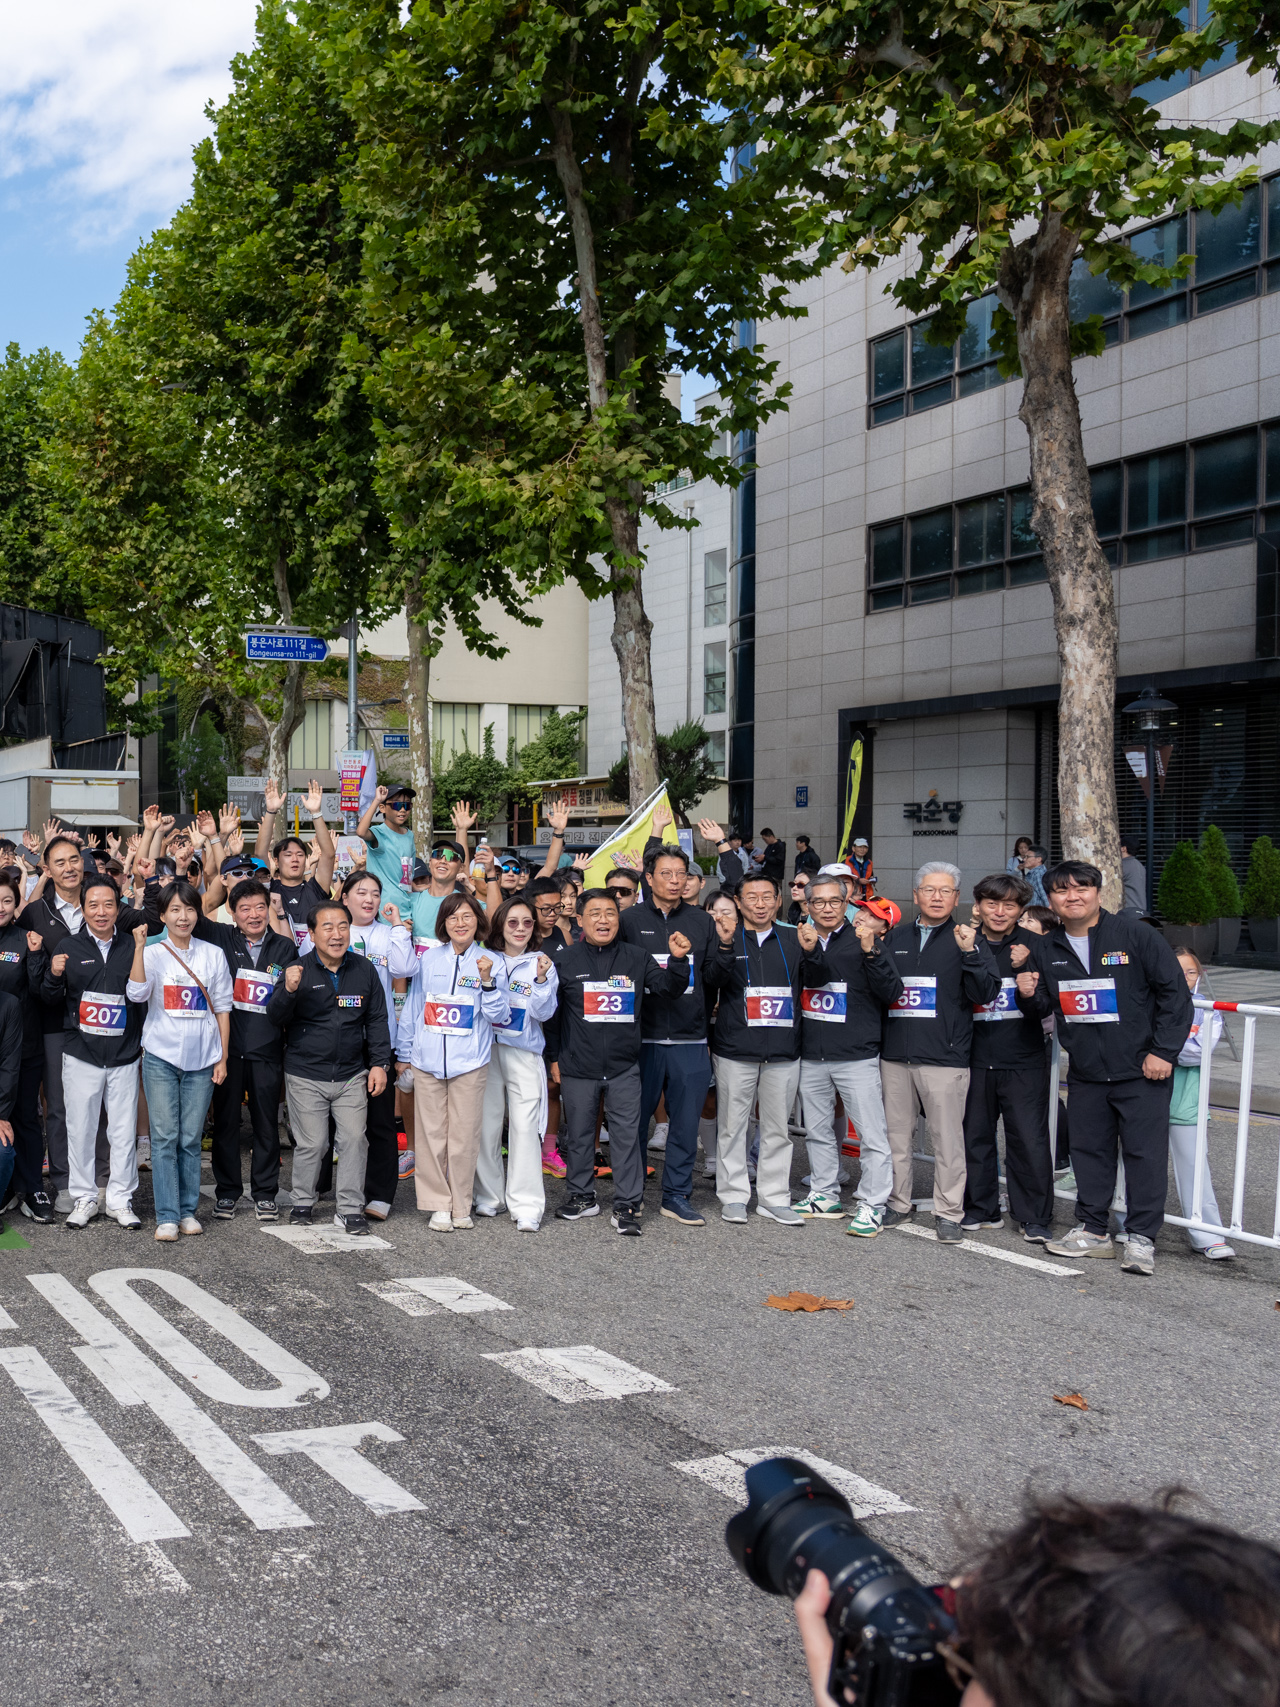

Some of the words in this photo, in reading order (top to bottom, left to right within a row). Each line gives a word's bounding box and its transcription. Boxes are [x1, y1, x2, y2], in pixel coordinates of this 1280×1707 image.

[249, 636, 307, 651] 봉은사로111길
[249, 649, 294, 659] Bongeunsa-ro
[295, 651, 317, 660] 111-gil
[561, 787, 577, 807] 정품
[578, 788, 592, 805] 정말
[903, 797, 964, 825] 국순당
[540, 830, 585, 845] 오교환
[913, 829, 959, 837] KOOKSOONDANG
[181, 990, 192, 1006] 9
[247, 984, 269, 1001] 19
[897, 990, 922, 1007] 55
[597, 995, 622, 1012] 23
[760, 999, 784, 1016] 37
[810, 993, 835, 1011] 60
[1074, 994, 1098, 1012] 31
[85, 1005, 122, 1026] 207
[435, 1006, 461, 1026] 20
